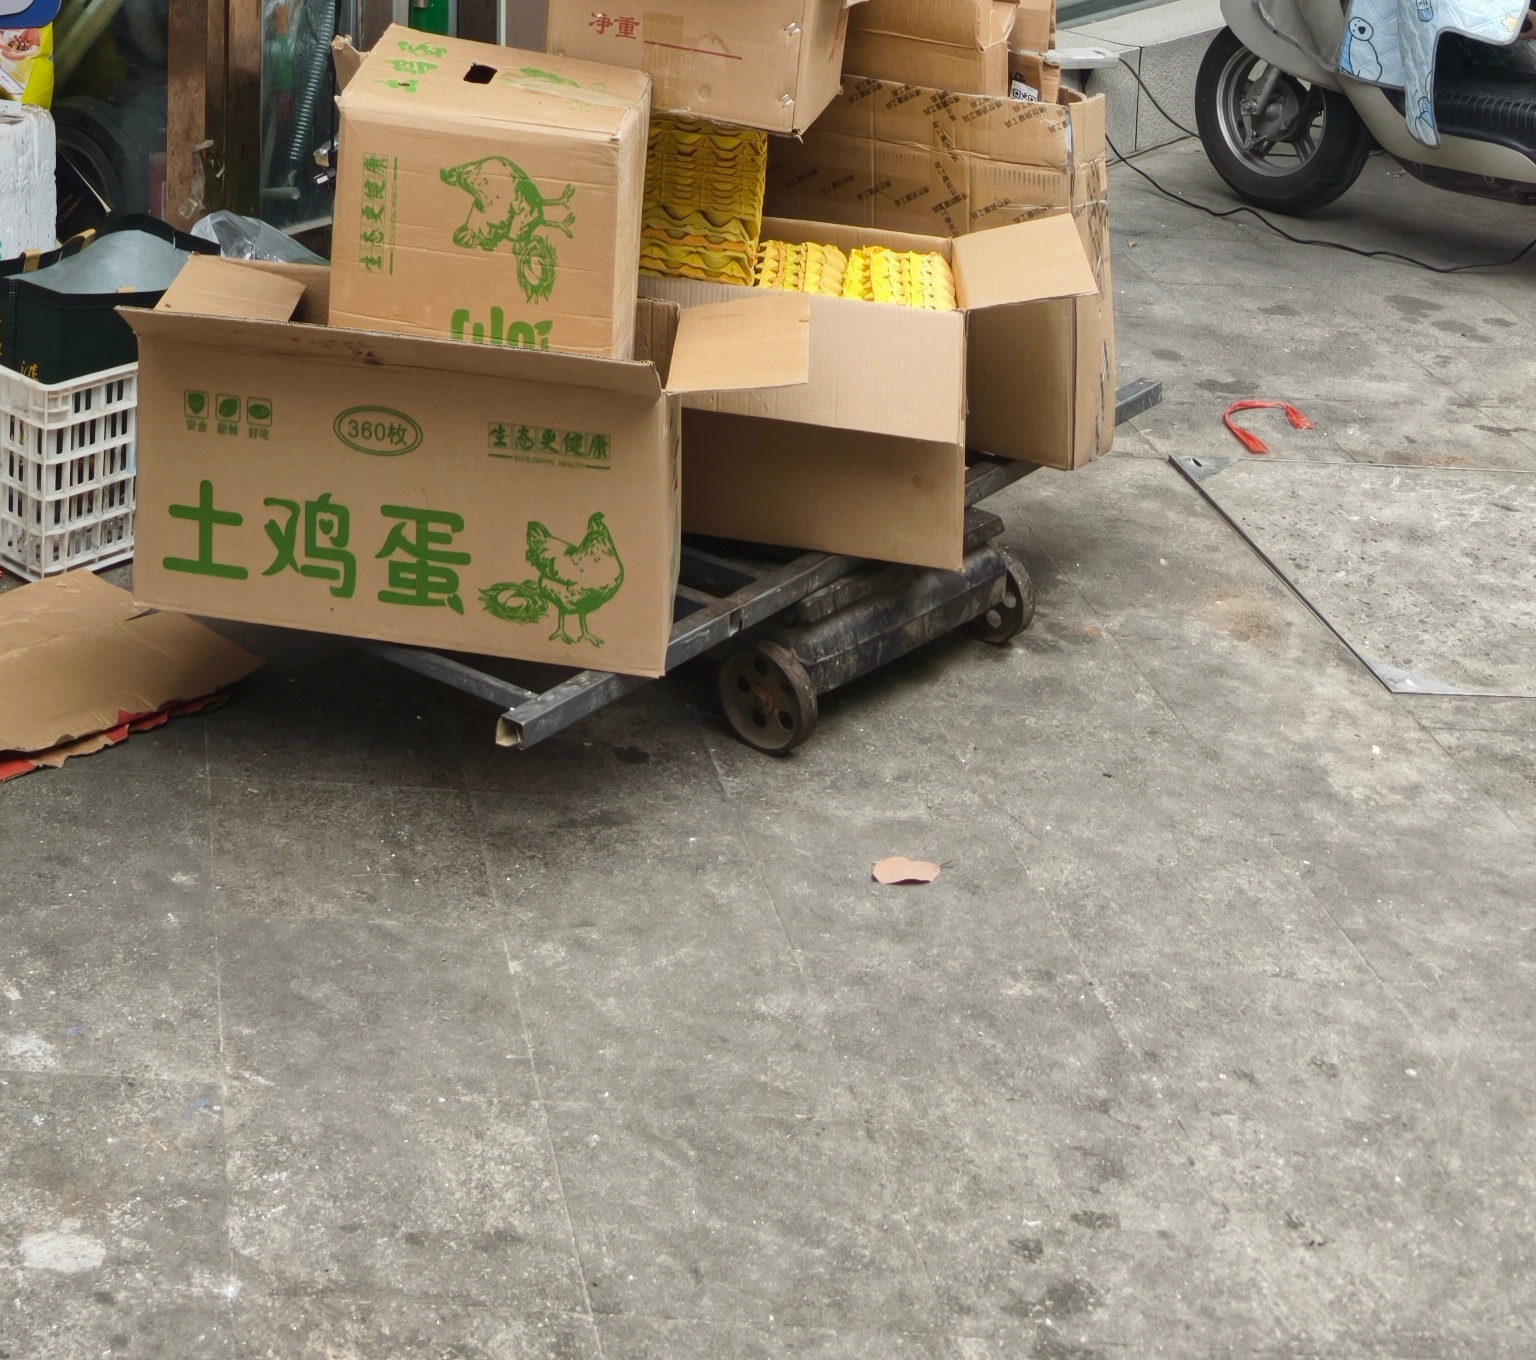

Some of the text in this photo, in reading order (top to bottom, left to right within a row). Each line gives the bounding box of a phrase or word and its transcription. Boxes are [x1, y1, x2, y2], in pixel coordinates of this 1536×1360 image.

[587, 10, 641, 40] 净重
[185, 418, 209, 435] 安全
[216, 422, 240, 438] 新鲜
[247, 425, 272, 442] 好吃
[347, 418, 408, 447] 360枚
[489, 423, 612, 460] 生态更健康
[162, 479, 472, 616] 土鸡蛋
